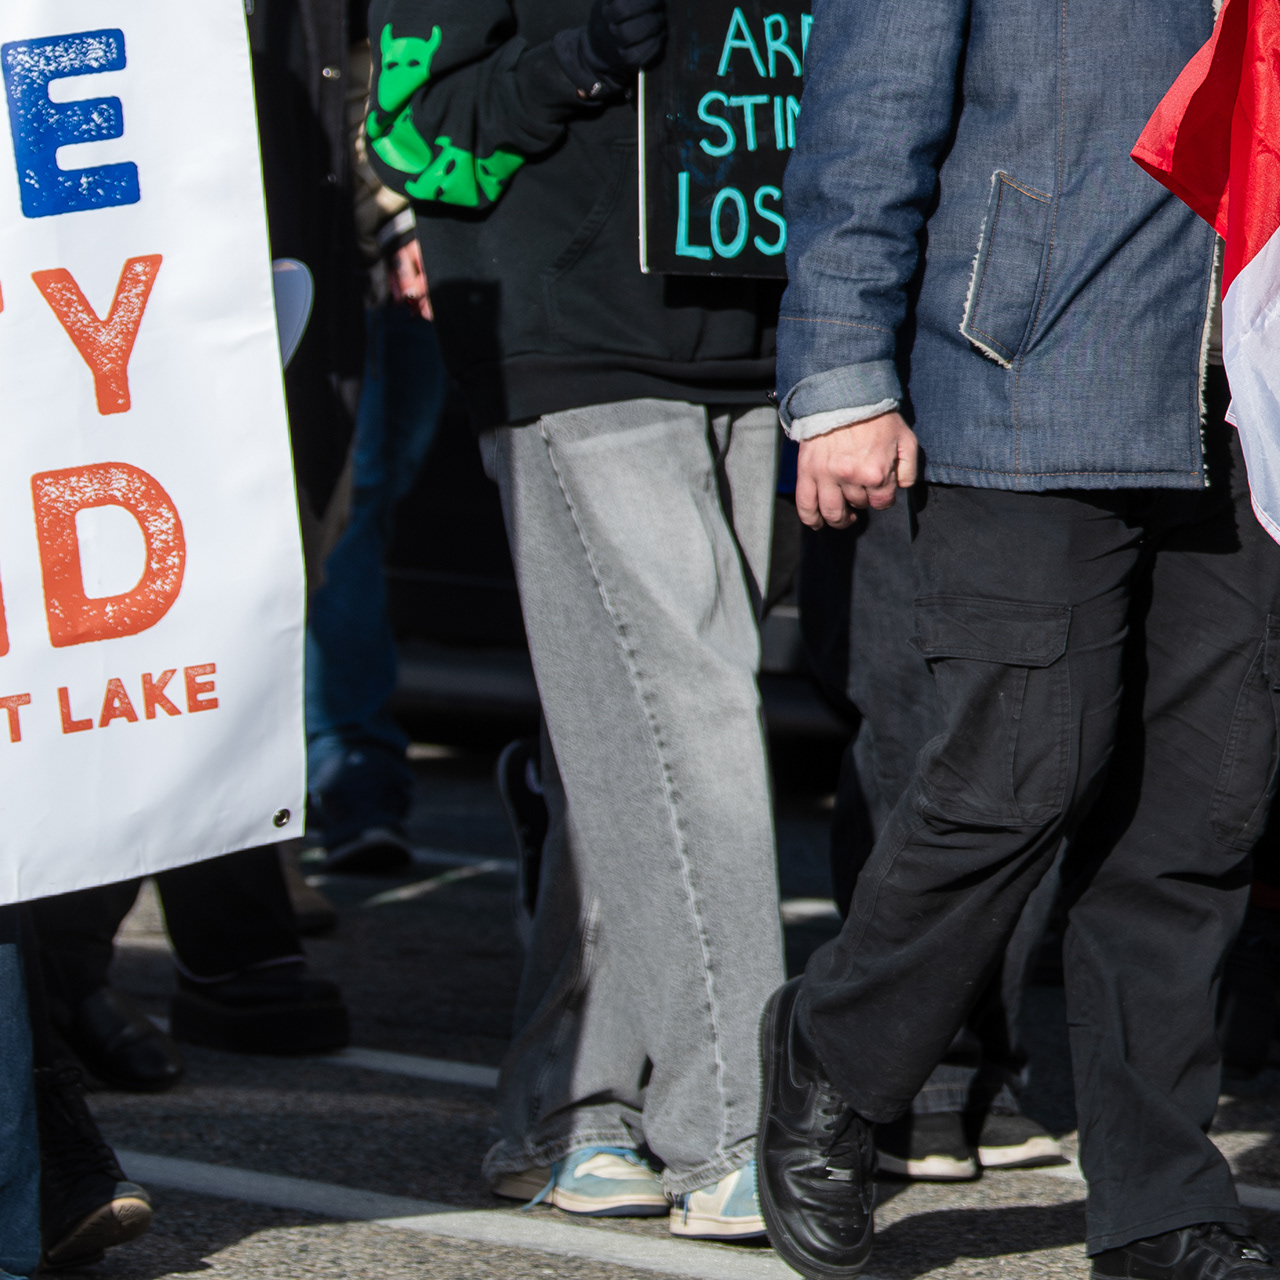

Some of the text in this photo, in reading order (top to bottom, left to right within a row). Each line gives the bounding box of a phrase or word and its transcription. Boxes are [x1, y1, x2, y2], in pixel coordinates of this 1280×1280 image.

[2, 28, 141, 219] E
[31, 253, 164, 416] Y
[56, 662, 220, 734] LAKE
